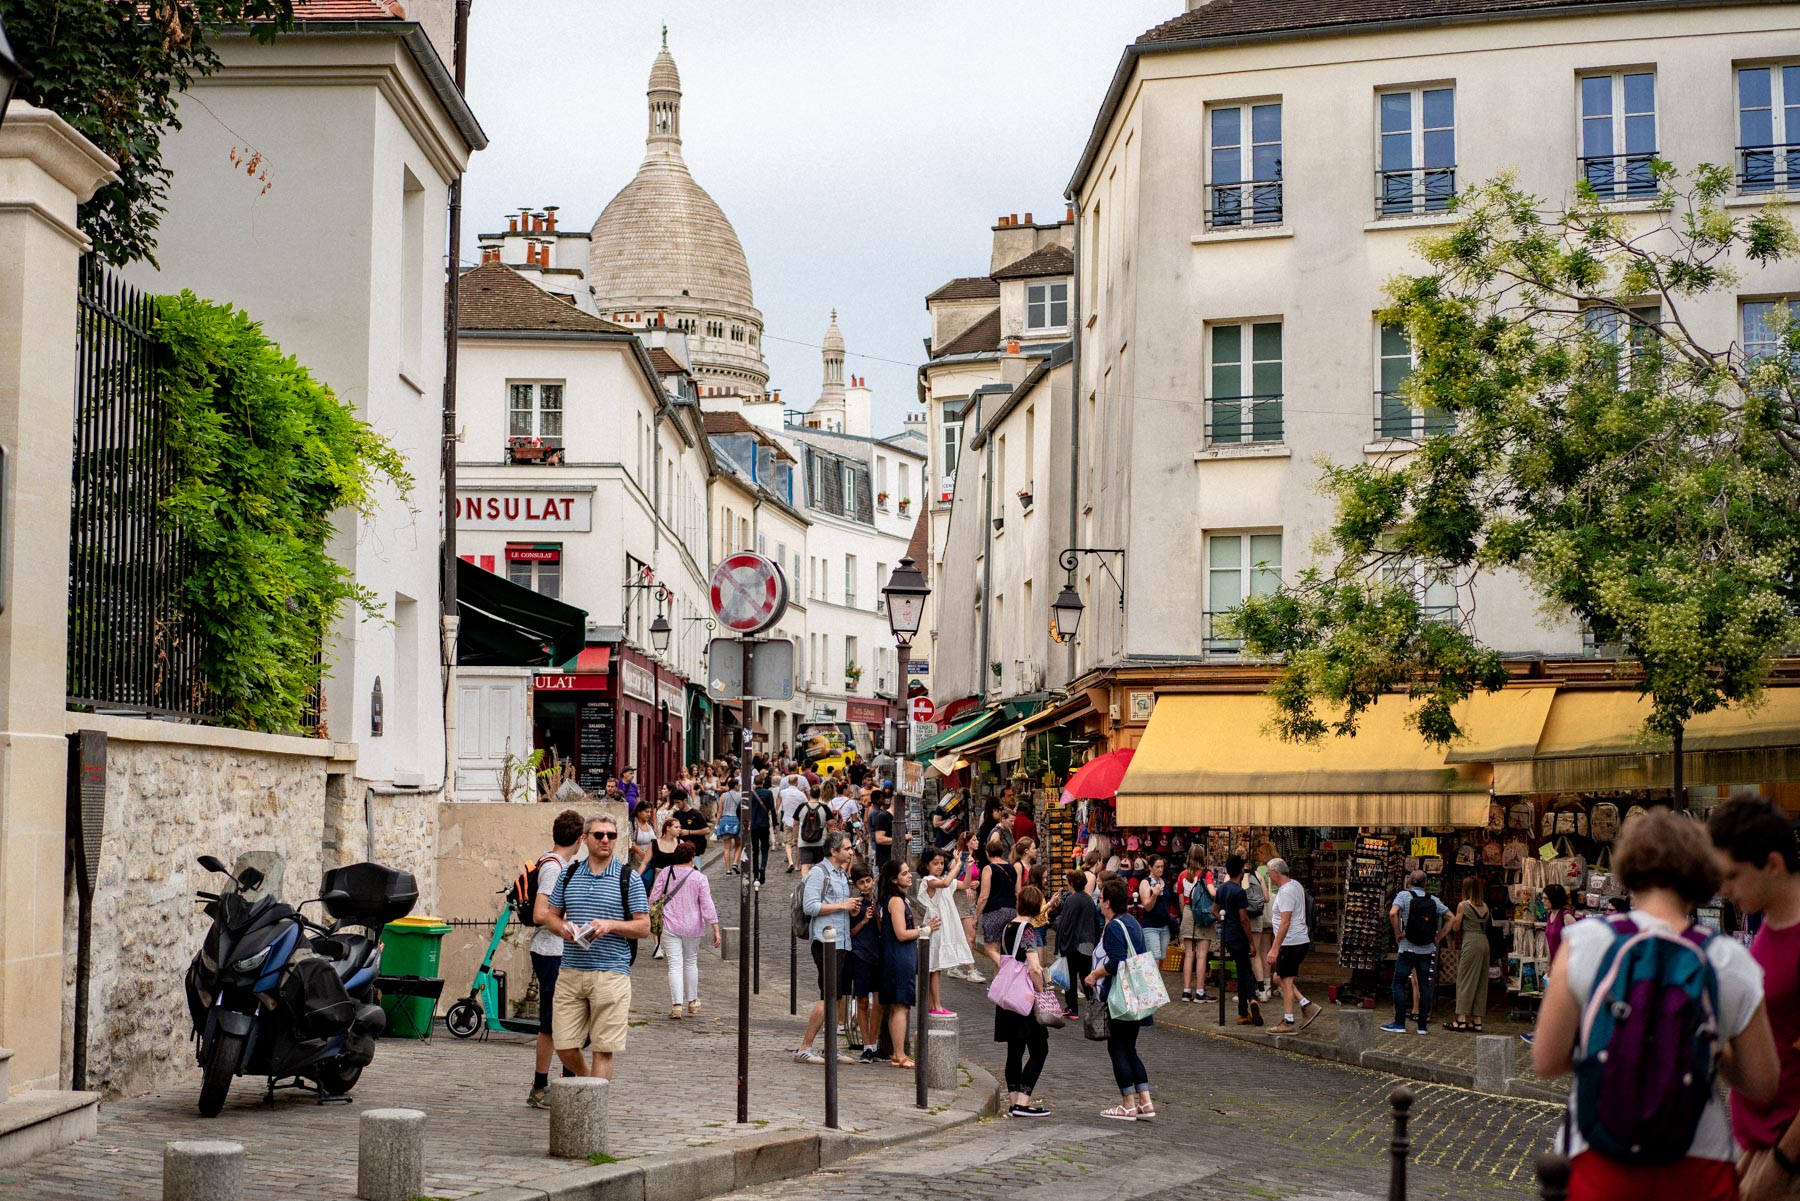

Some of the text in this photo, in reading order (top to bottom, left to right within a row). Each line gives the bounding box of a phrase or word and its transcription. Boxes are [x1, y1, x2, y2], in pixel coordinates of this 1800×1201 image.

[440, 497, 575, 521] NSULAT
[521, 551, 552, 559] CONSULAT
[533, 676, 576, 689] ULAT
